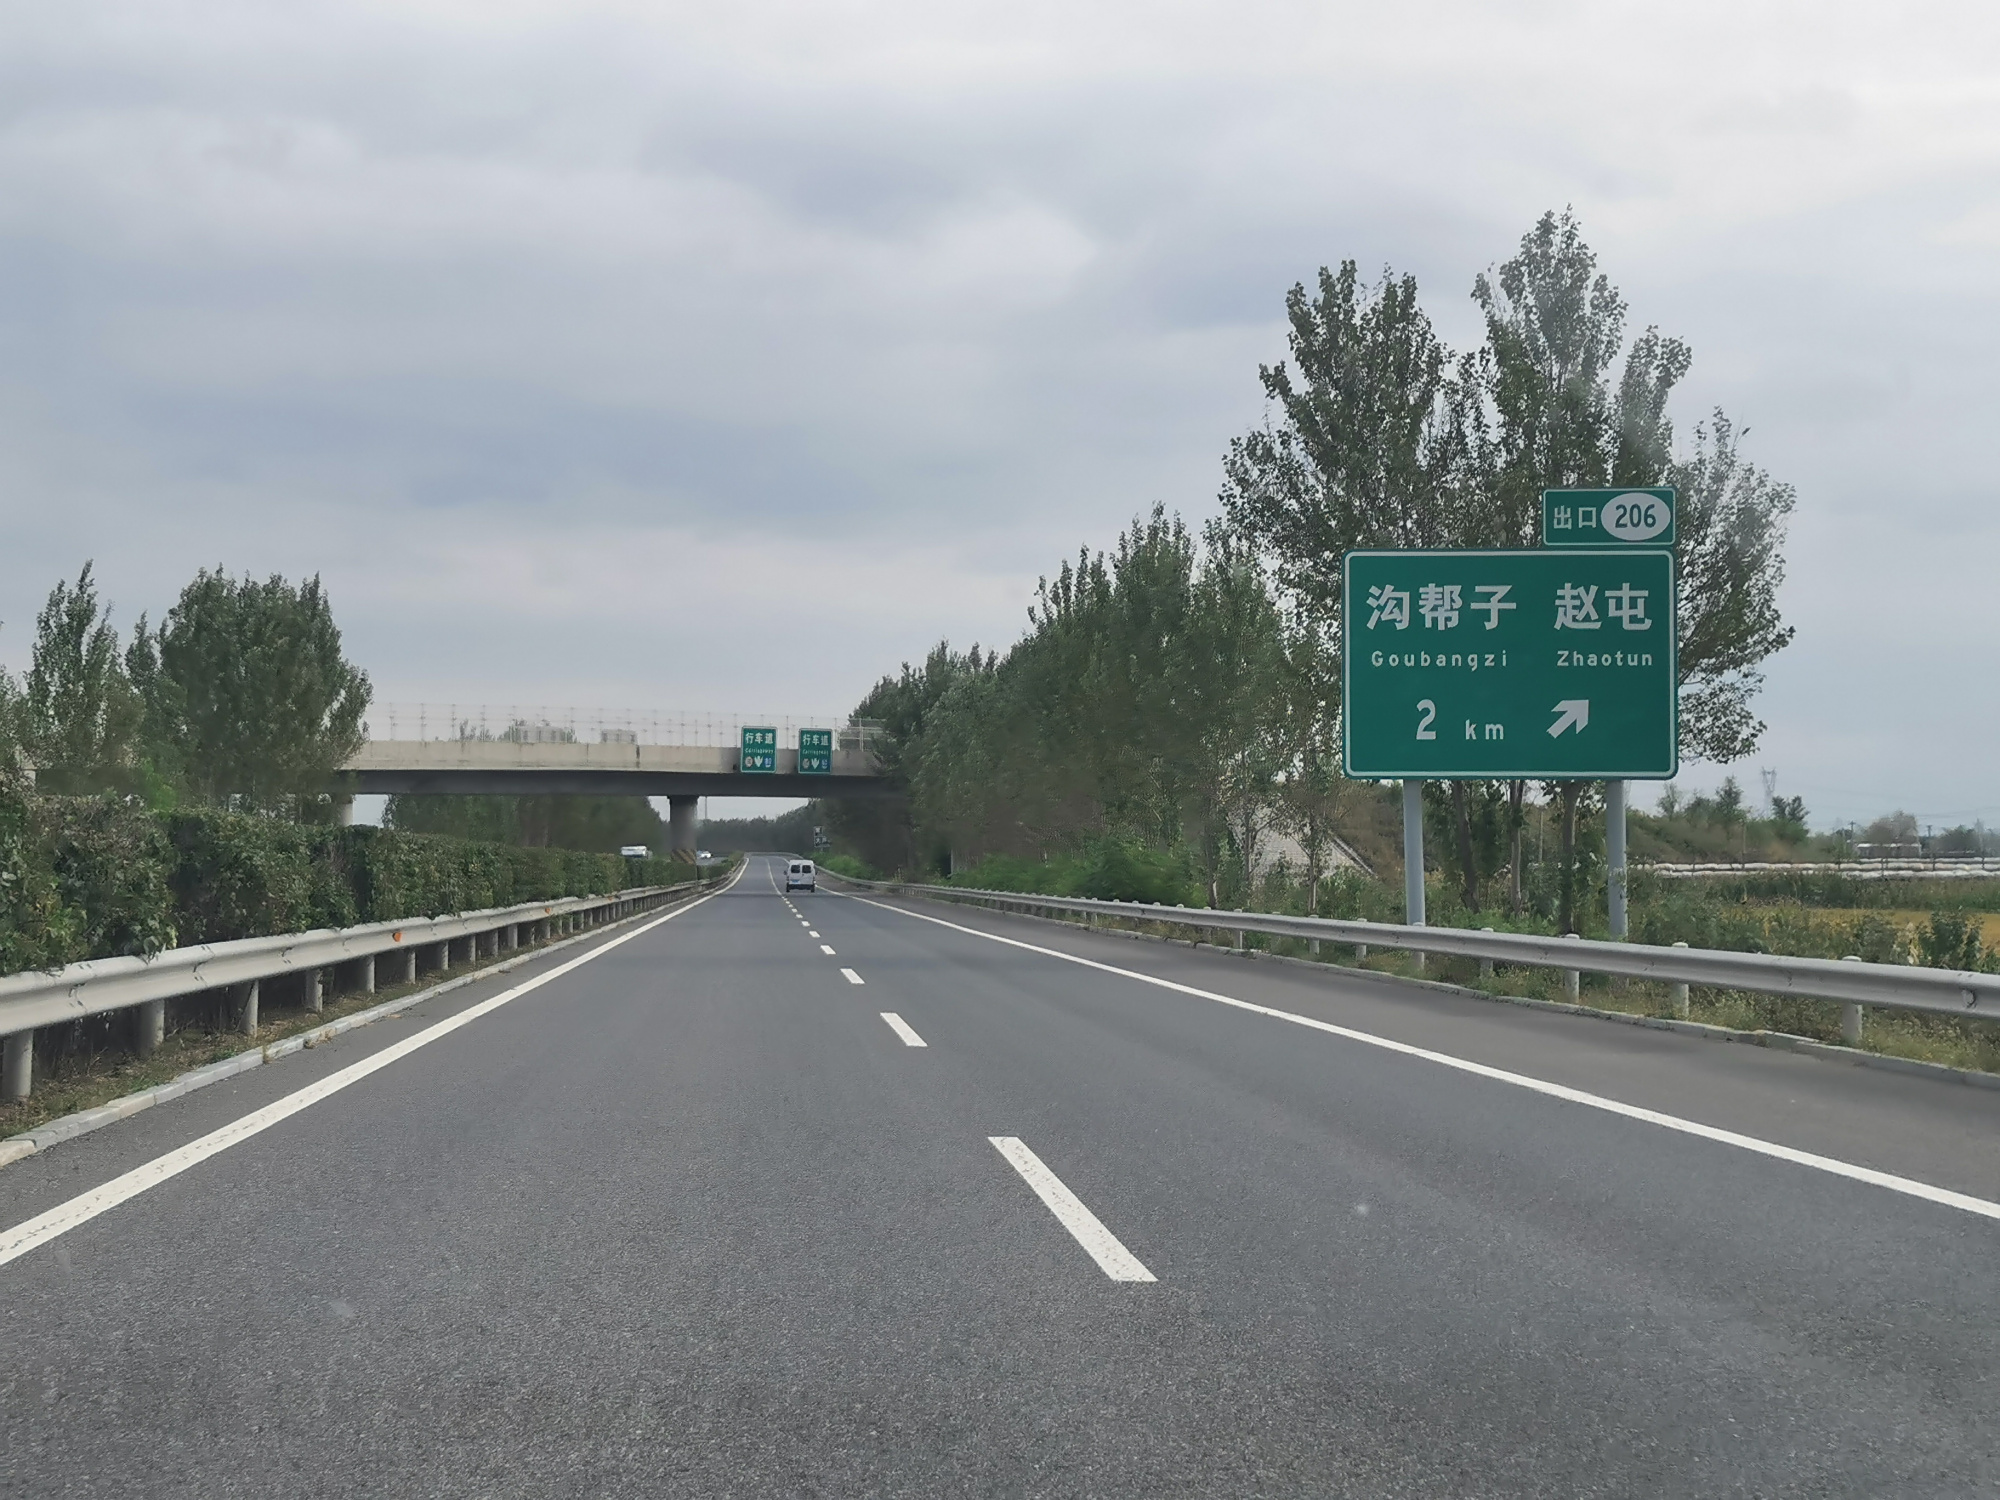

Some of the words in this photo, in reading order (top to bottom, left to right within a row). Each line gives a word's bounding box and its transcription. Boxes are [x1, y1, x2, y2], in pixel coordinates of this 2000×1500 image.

[1553, 504, 1597, 530] 出口
[1614, 503, 1657, 529] 206
[1366, 582, 1517, 631] 沟帮子
[1553, 582, 1653, 631] 赵屯
[1371, 649, 1507, 672] Goubangzi
[1556, 650, 1653, 667] Zhaotun
[1415, 698, 1437, 741] 2
[1465, 718, 1504, 740] km
[745, 732, 774, 744] 行车道
[802, 733, 829, 746] 行车道
